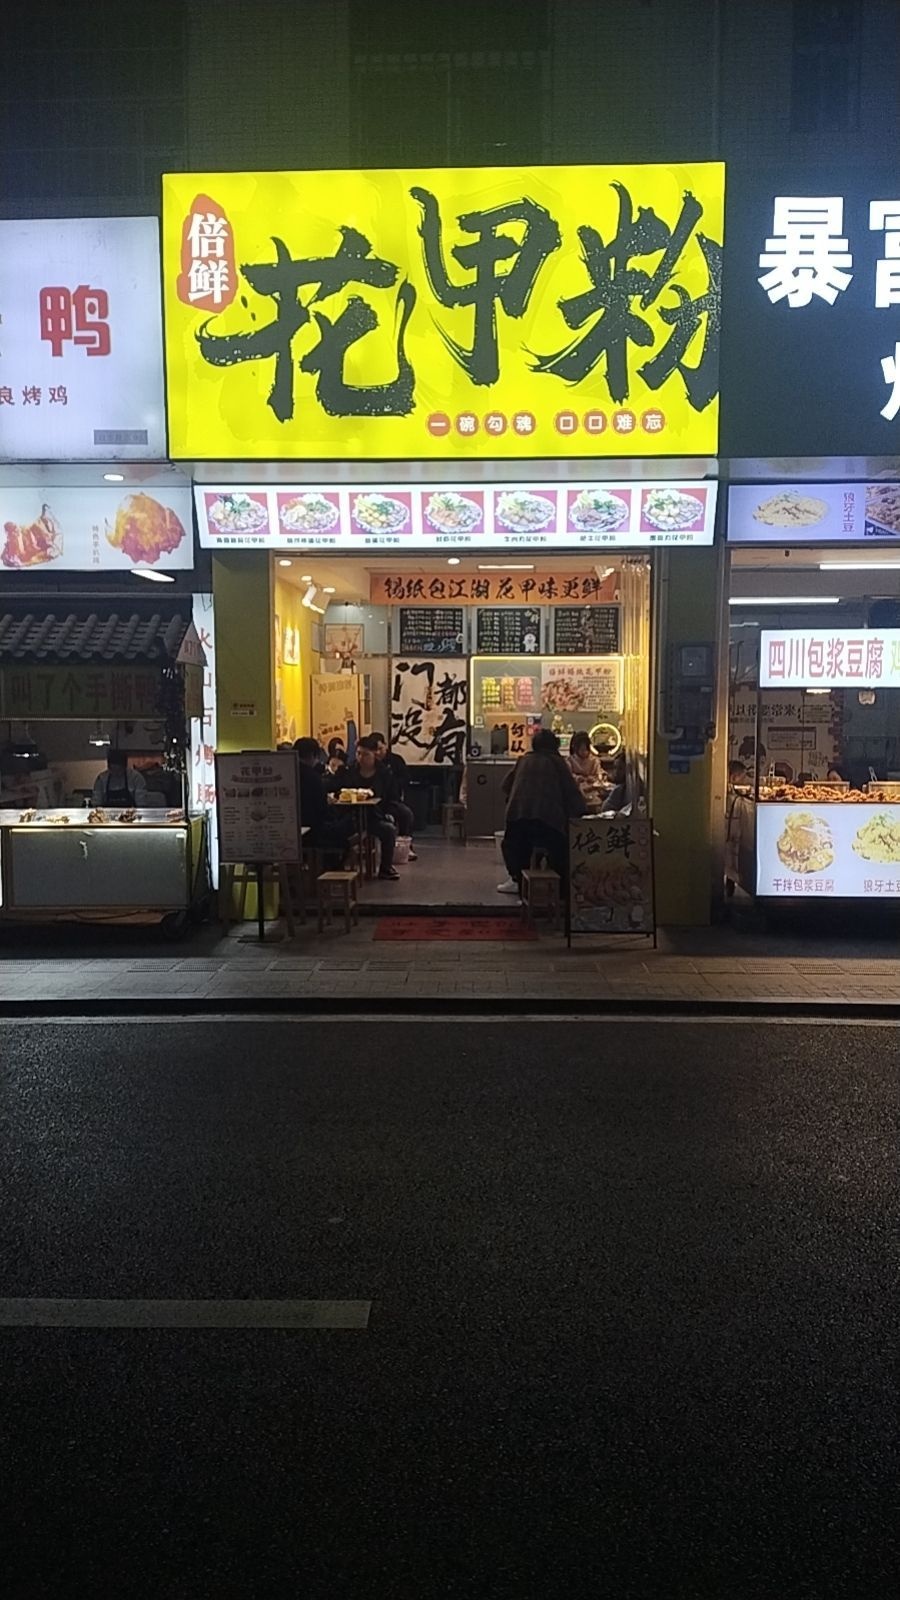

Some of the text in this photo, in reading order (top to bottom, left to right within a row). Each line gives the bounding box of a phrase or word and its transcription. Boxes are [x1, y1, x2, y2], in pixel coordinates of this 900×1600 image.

[188, 212, 228, 304] 倍鲜
[39, 285, 111, 358] 鸭
[195, 180, 720, 423] 花甲粉
[0, 385, 68, 406] 良烤鸡
[430, 413, 663, 432] 一碗勾魂 口口难忘
[842, 492, 856, 533] 狼牙土豆
[768, 637, 884, 679] 四川包浆豆腐
[571, 824, 636, 859] 倍鲜
[772, 878, 835, 893] 干拌包浆豆腐
